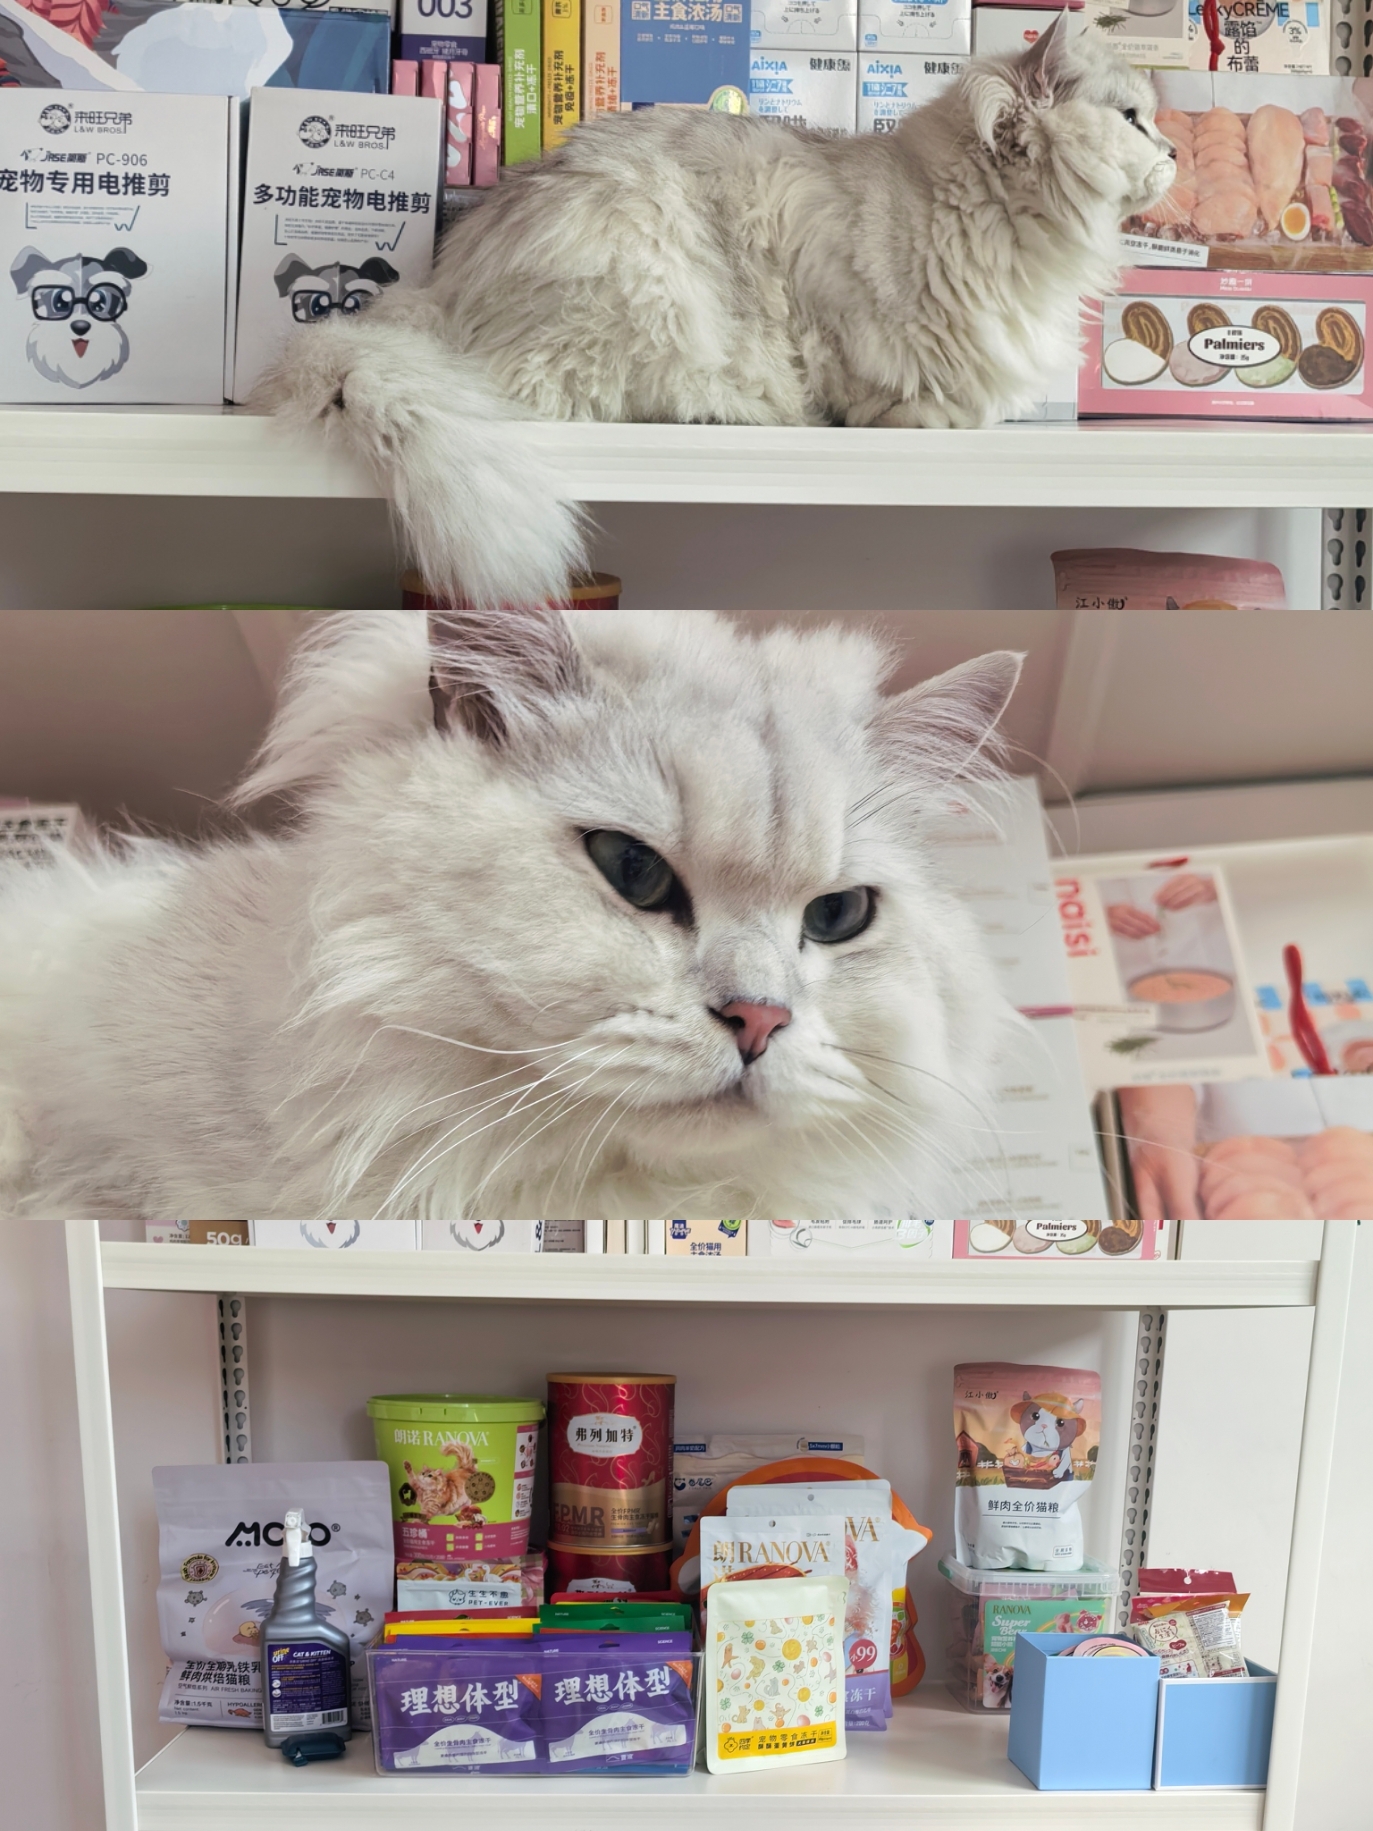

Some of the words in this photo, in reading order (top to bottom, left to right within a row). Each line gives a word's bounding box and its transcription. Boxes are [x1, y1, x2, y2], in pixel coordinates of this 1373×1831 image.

[653, 3, 723, 21] 主食浓汤
[1234, 39, 1250, 54] 的
[1227, 56, 1259, 72] 布蕾
[74, 111, 133, 134] 来旺兄弟
[335, 124, 396, 150] 来旺兄弟
[96, 153, 147, 166] PC-906
[360, 169, 395, 180] PC-C4
[0, 169, 171, 197] 宠物专用电推剪
[253, 183, 432, 214] 多功能宠物电推剪
[1204, 338, 1265, 351] Palmiers
[1036, 1222, 1077, 1231] Palmiers
[690, 1242, 722, 1251] 全价猫用
[394, 1428, 420, 1445] 朗诺
[423, 1431, 489, 1446] RANOVA
[575, 1427, 634, 1443] 弗列加特
[988, 1500, 1059, 1513] 鲜肉全价猫粮
[738, 1541, 831, 1563] RANOVA
[992, 1605, 1032, 1614] RANOVA
[992, 1615, 1031, 1630] Super
[272, 1654, 284, 1663] OFF
[179, 1670, 251, 1686] 鲜肉烘焙猫粮
[554, 1666, 671, 1705] 理想体型
[400, 1679, 519, 1716] 理想体型
[758, 1729, 817, 1743] 宠物零食冻干
